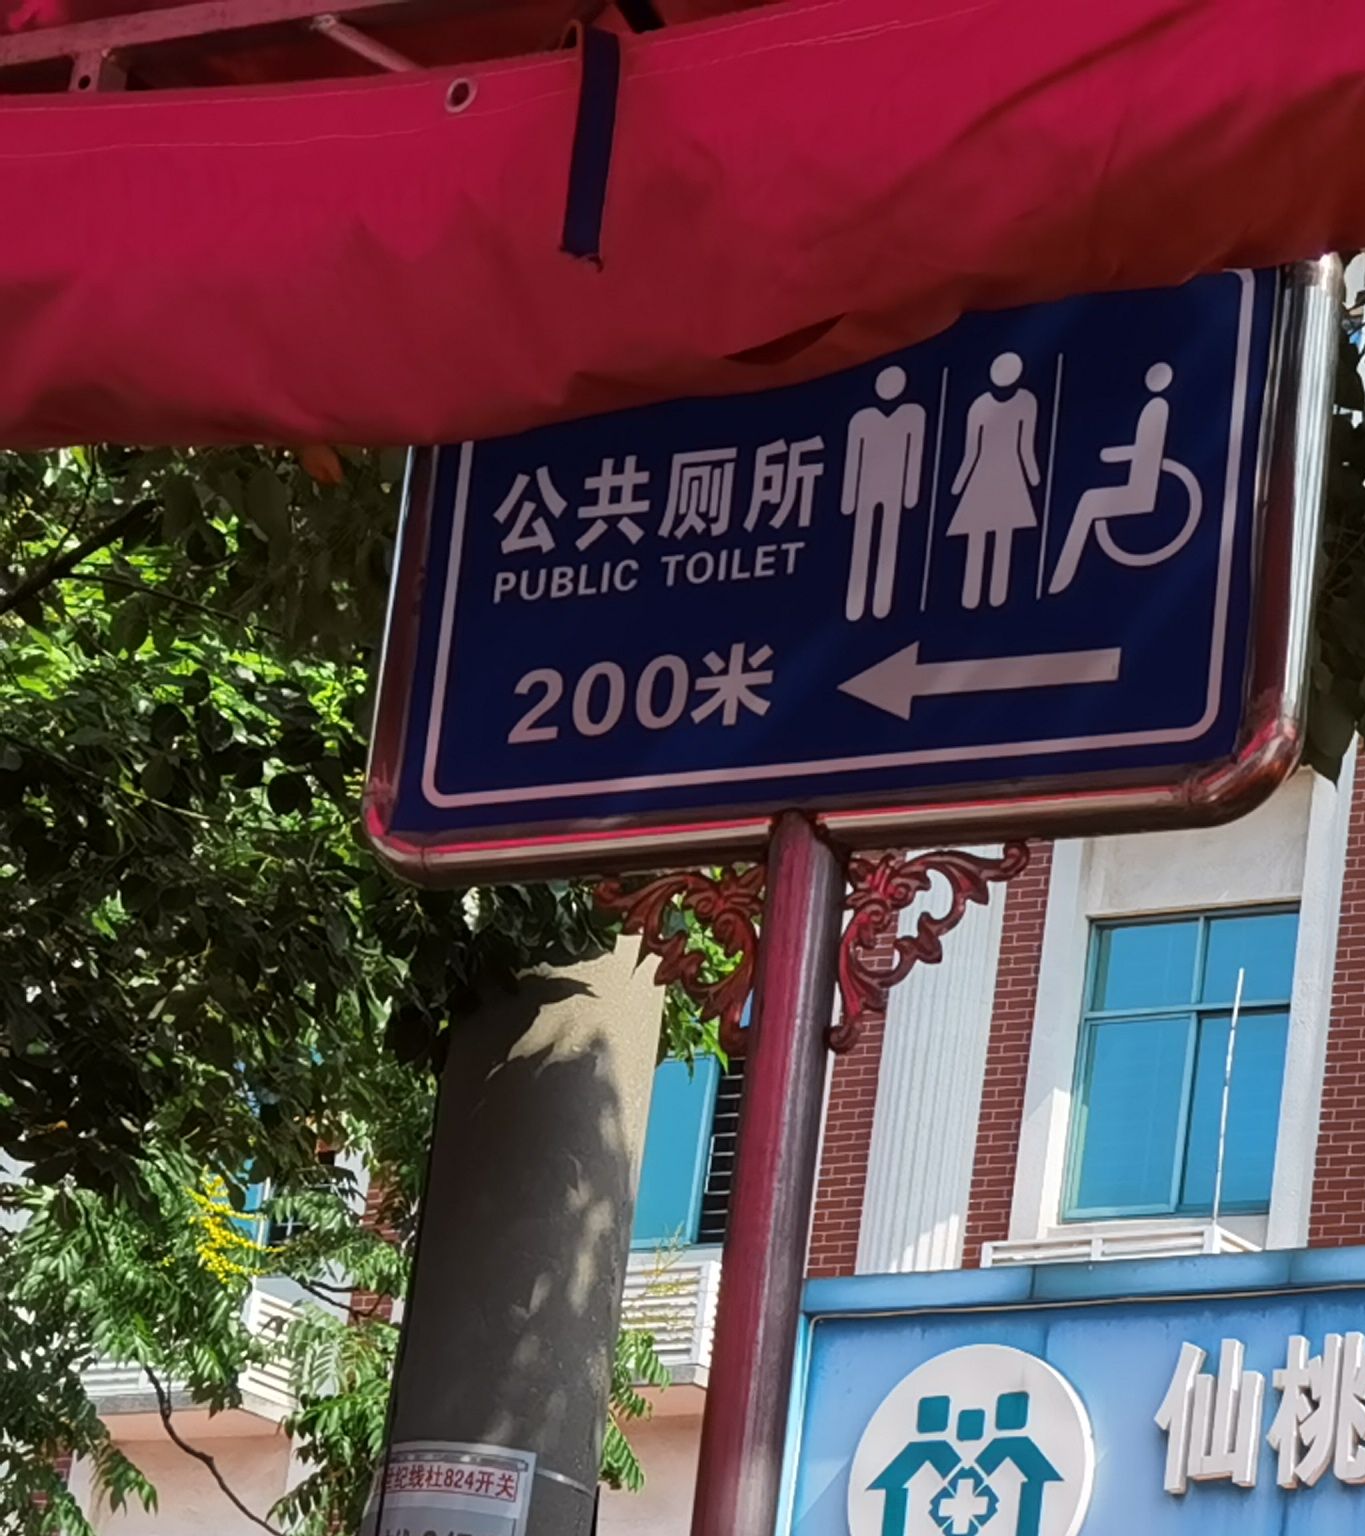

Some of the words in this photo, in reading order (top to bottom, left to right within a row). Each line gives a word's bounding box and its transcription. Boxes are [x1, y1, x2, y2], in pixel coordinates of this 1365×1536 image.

[493, 435, 825, 555] 公共厕所
[493, 560, 639, 604] PUBLIC
[662, 542, 805, 588] TOILET
[507, 643, 774, 745] 200米
